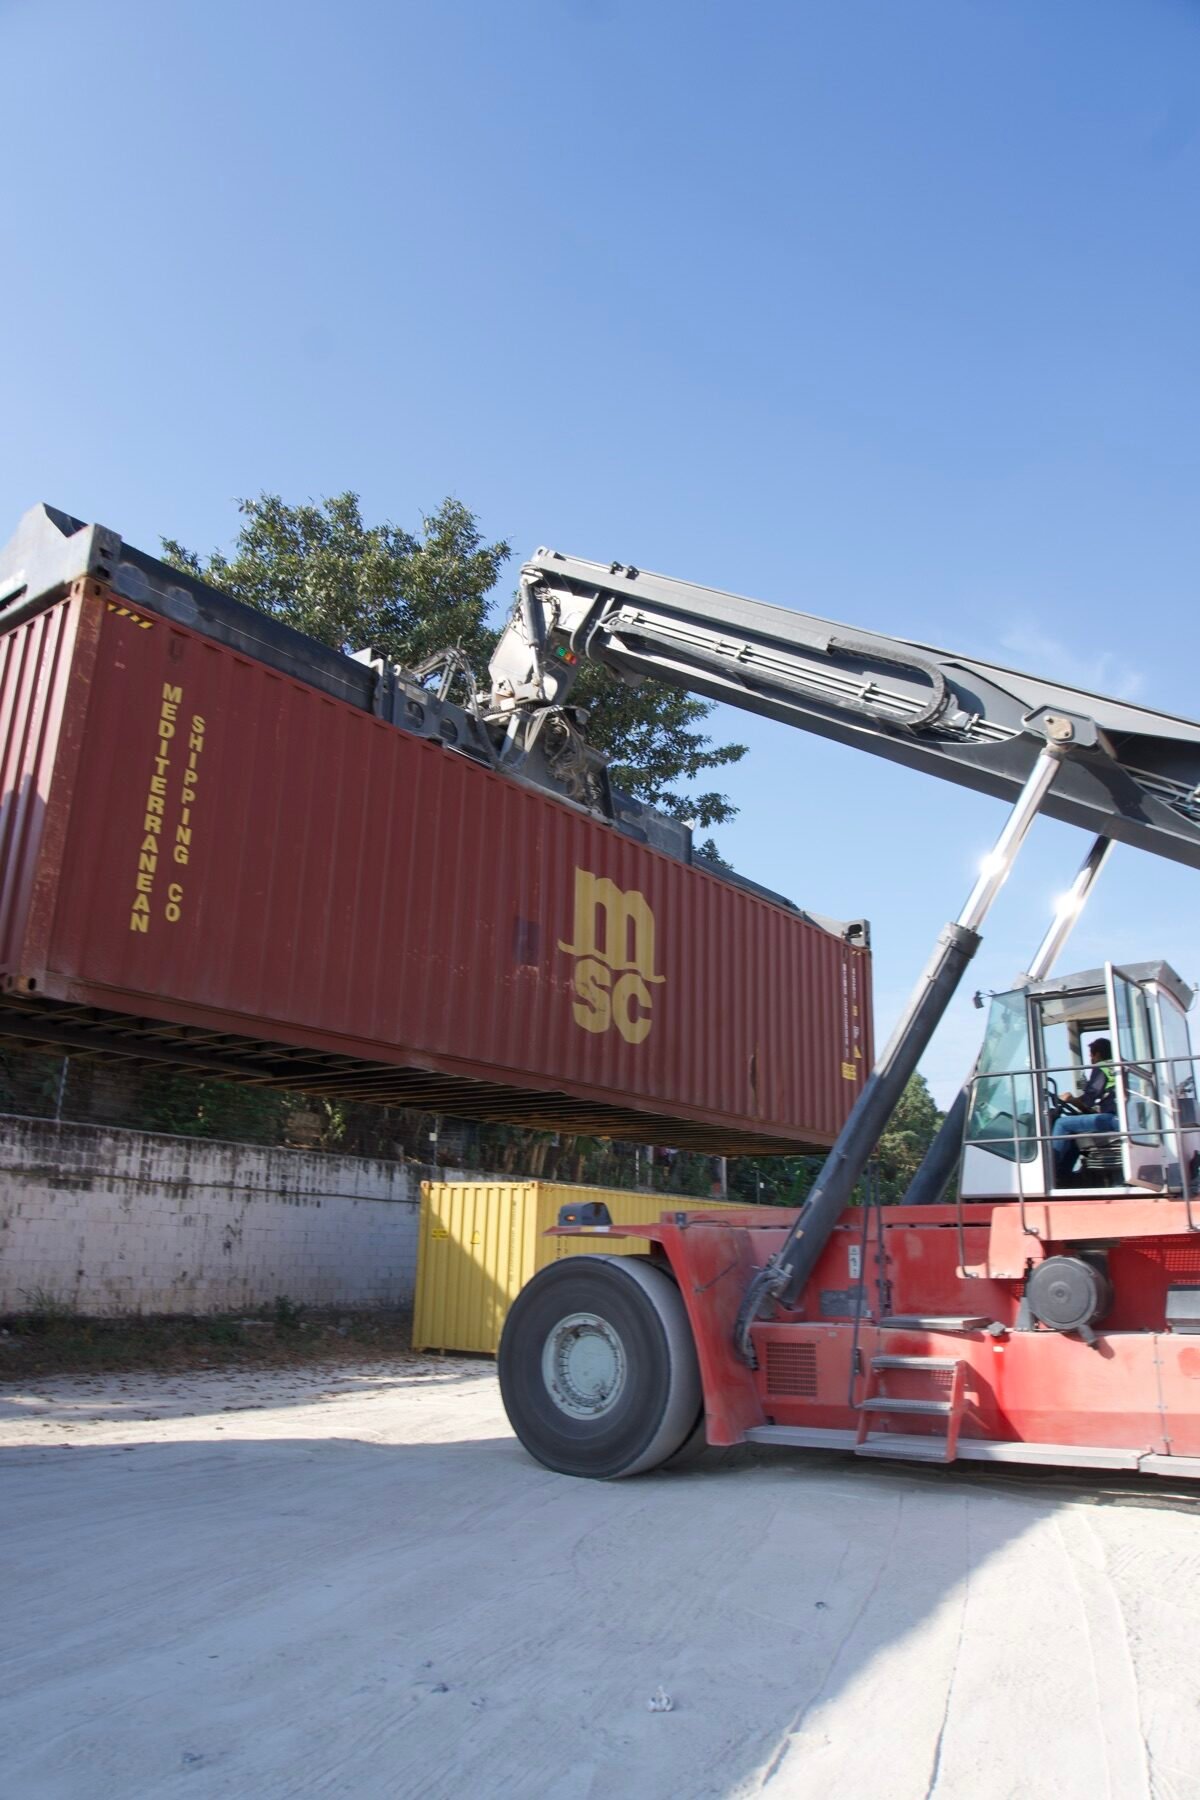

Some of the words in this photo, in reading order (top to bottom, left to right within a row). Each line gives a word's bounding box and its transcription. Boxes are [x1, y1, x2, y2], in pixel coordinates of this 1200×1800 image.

[130, 682, 183, 933] MEDITERRANEAN
[173, 714, 206, 865] SHIPPING
[165, 882, 184, 922] CO
